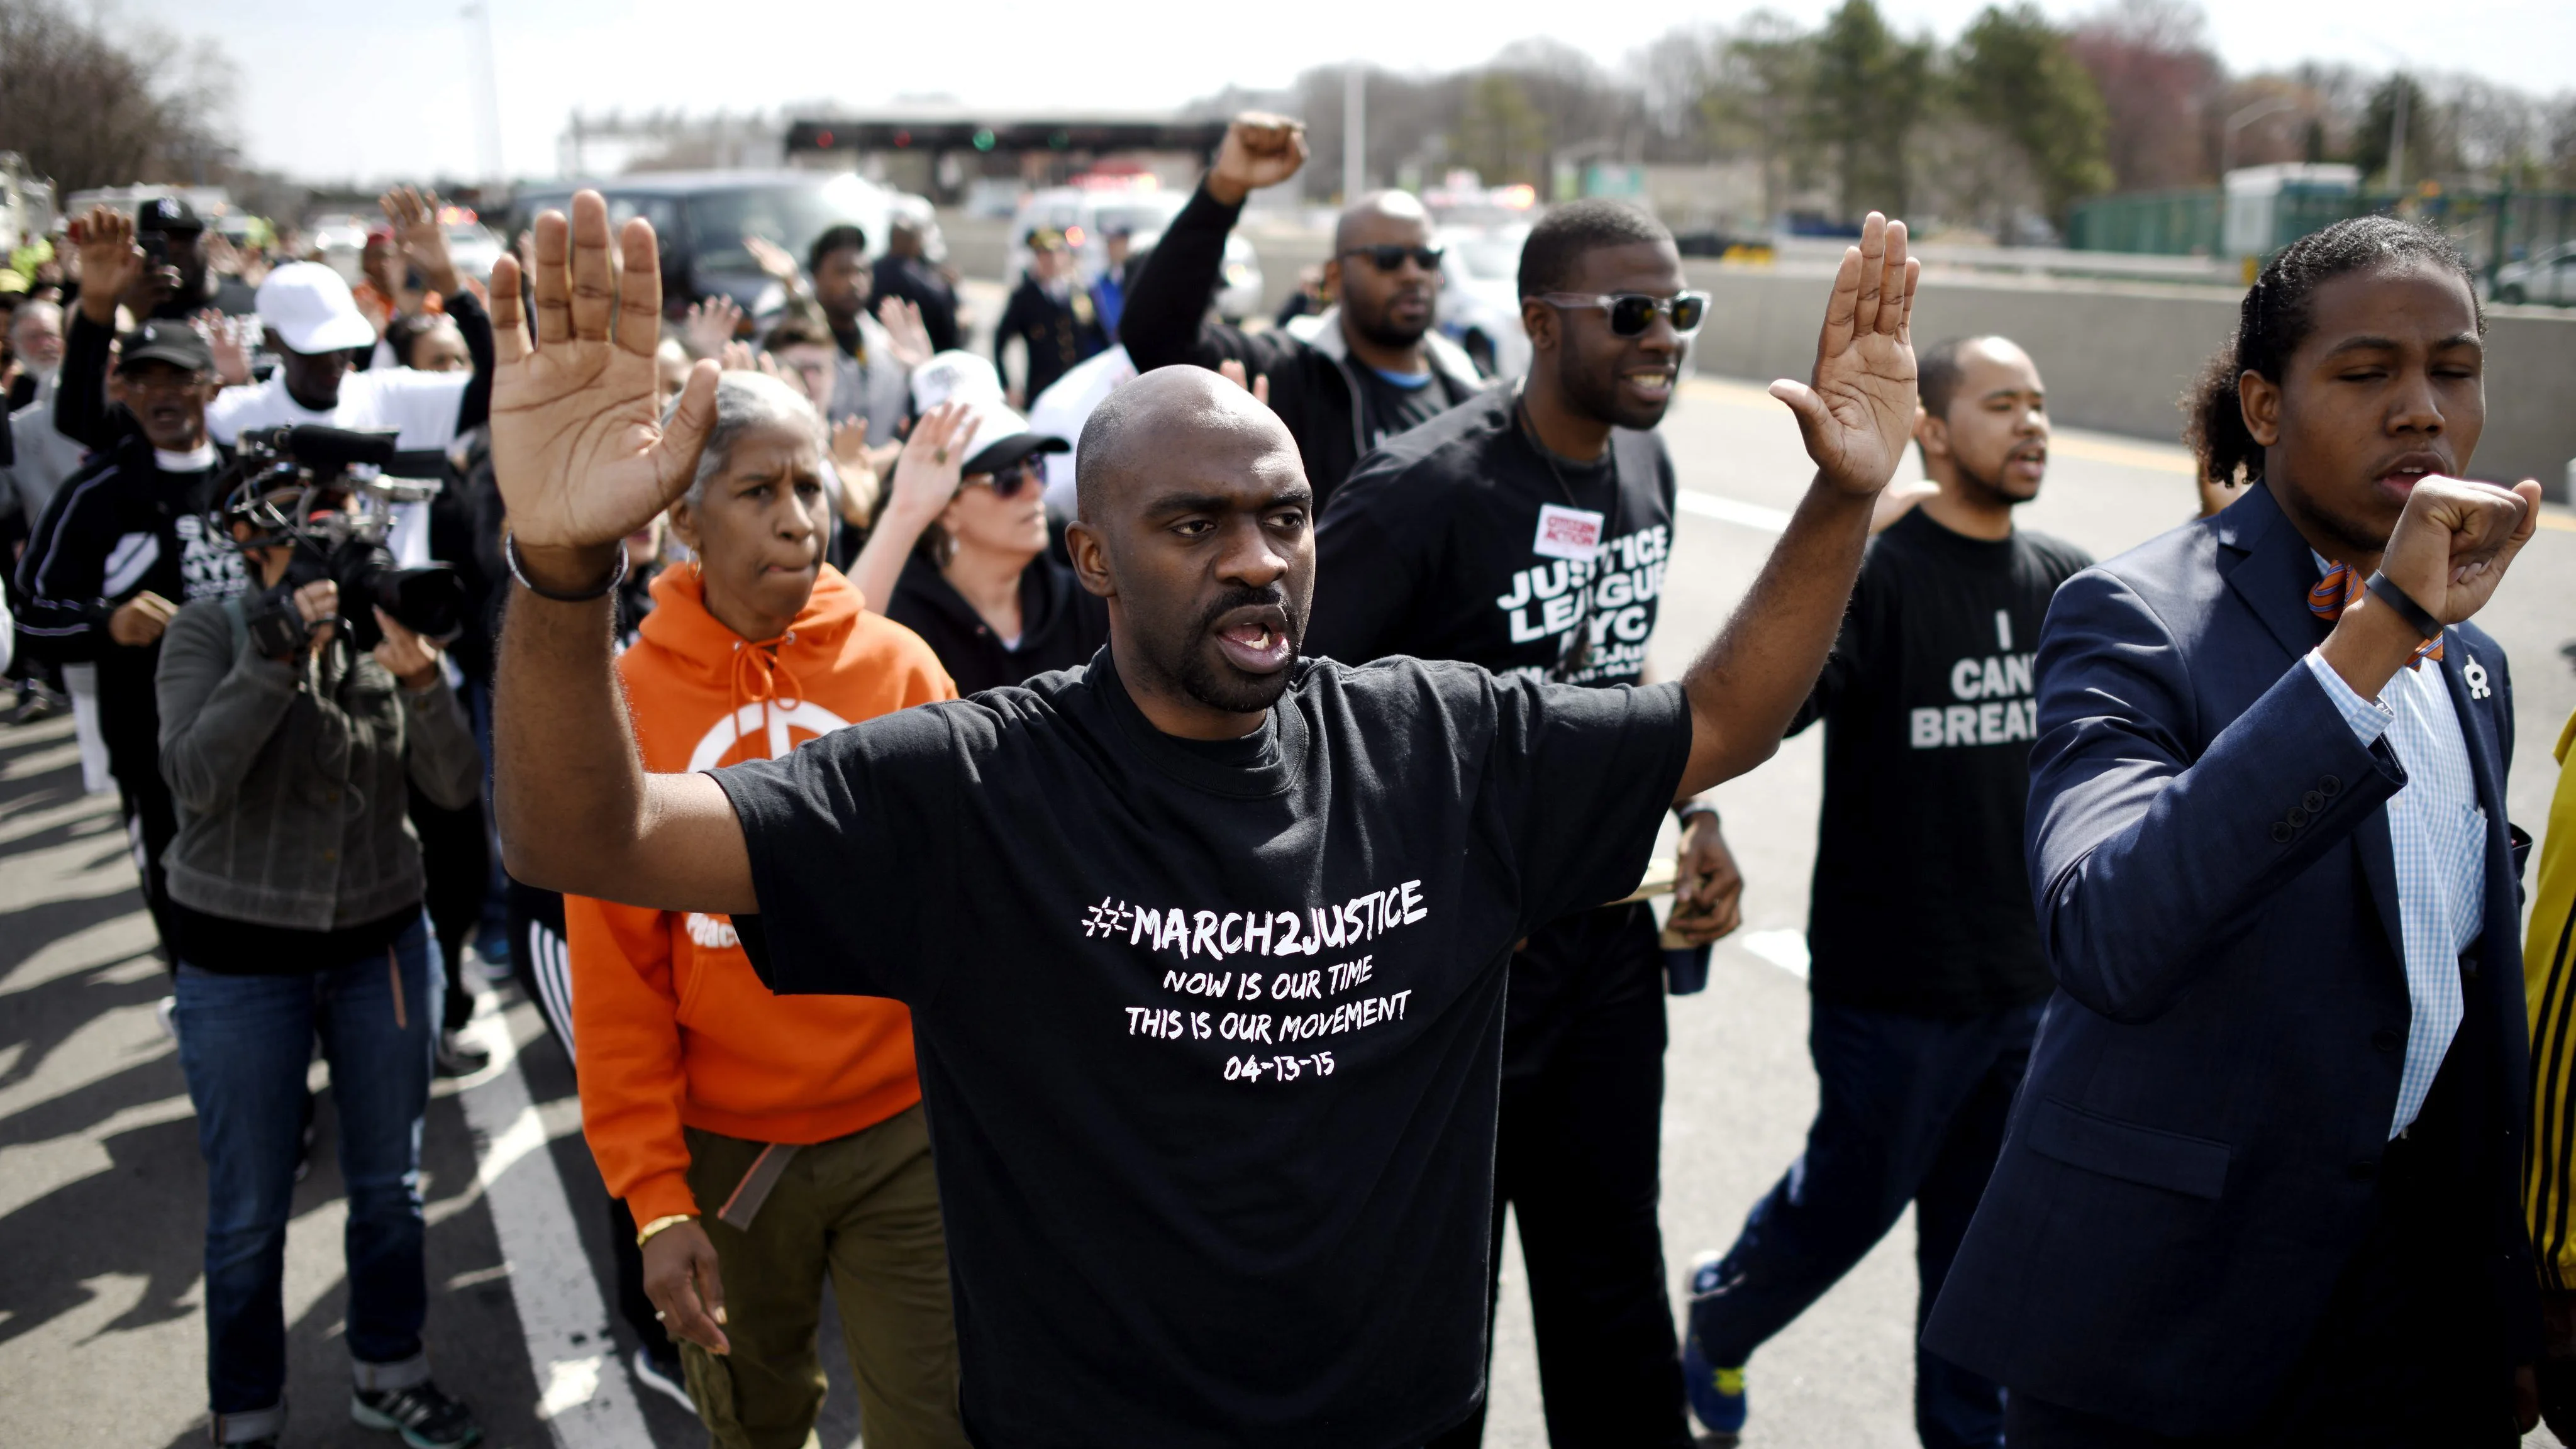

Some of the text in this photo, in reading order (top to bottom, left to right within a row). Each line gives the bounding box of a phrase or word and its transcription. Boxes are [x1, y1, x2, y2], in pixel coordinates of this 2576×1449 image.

[1996, 610, 2012, 650] I
[1951, 653, 2037, 700] CAN
[1911, 698, 2037, 748] BREAT
[686, 913, 741, 949] Peac
[1082, 879, 1428, 960] #MARCH2JUSTICE
[1163, 954, 1373, 1001] NOW IS OUR TIME
[1125, 989, 1412, 1045] THIS IS OUR MOVEMENT
[1223, 1051, 1335, 1084] 04-13-15
